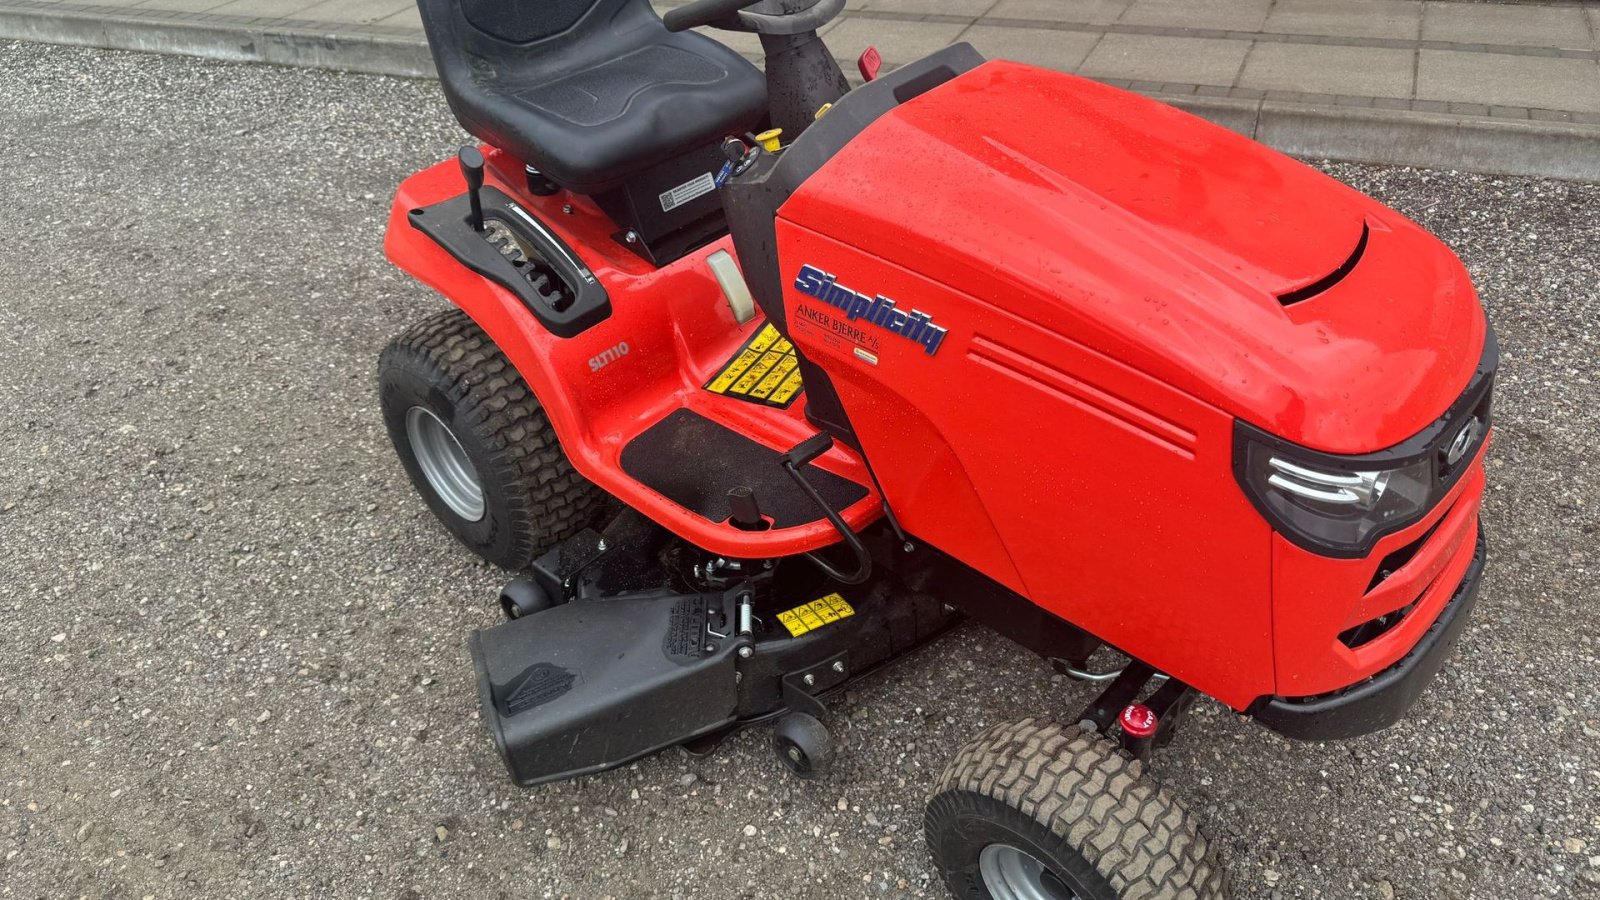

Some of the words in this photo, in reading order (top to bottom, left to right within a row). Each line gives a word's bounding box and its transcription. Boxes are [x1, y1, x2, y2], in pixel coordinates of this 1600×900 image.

[794, 263, 949, 356] Simplicity
[796, 304, 830, 326] ANKER
[832, 319, 867, 344] BJERRE
[588, 341, 630, 372] SLT110
[1143, 710, 1154, 728] CAST
